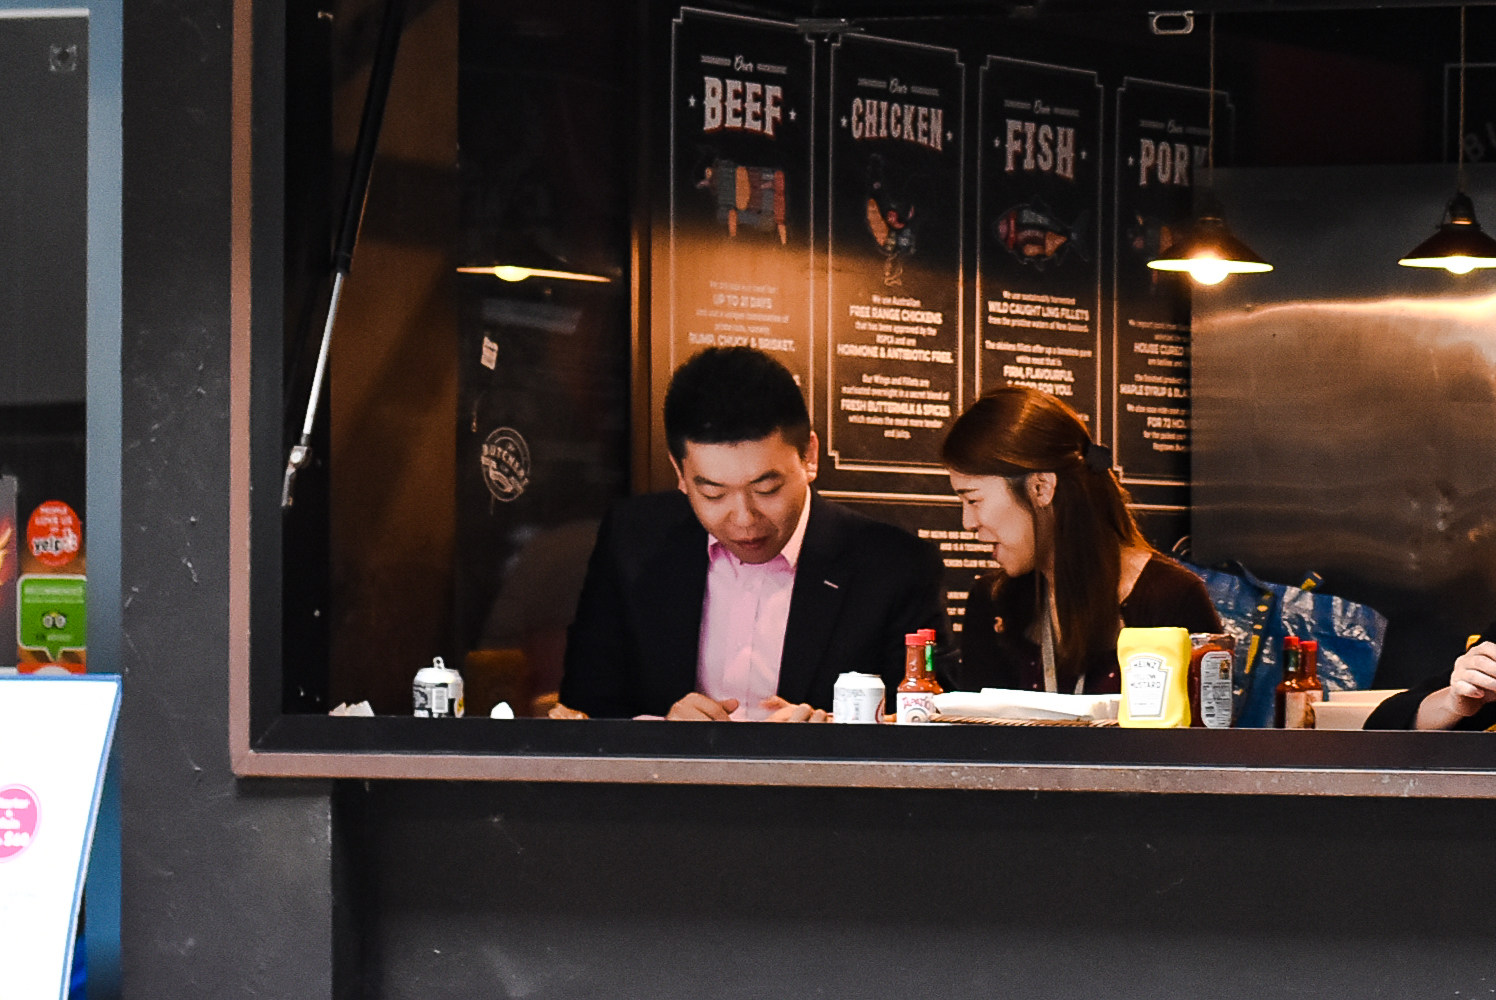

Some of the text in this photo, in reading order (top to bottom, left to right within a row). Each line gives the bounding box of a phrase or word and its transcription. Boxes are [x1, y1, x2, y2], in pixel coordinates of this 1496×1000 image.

[703, 76, 782, 138] BEEF
[852, 98, 944, 151] CHICKEN
[1004, 119, 1076, 181] FISH
[849, 304, 870, 318] FREE
[871, 306, 900, 321] RANGE
[988, 300, 1009, 314] WILD
